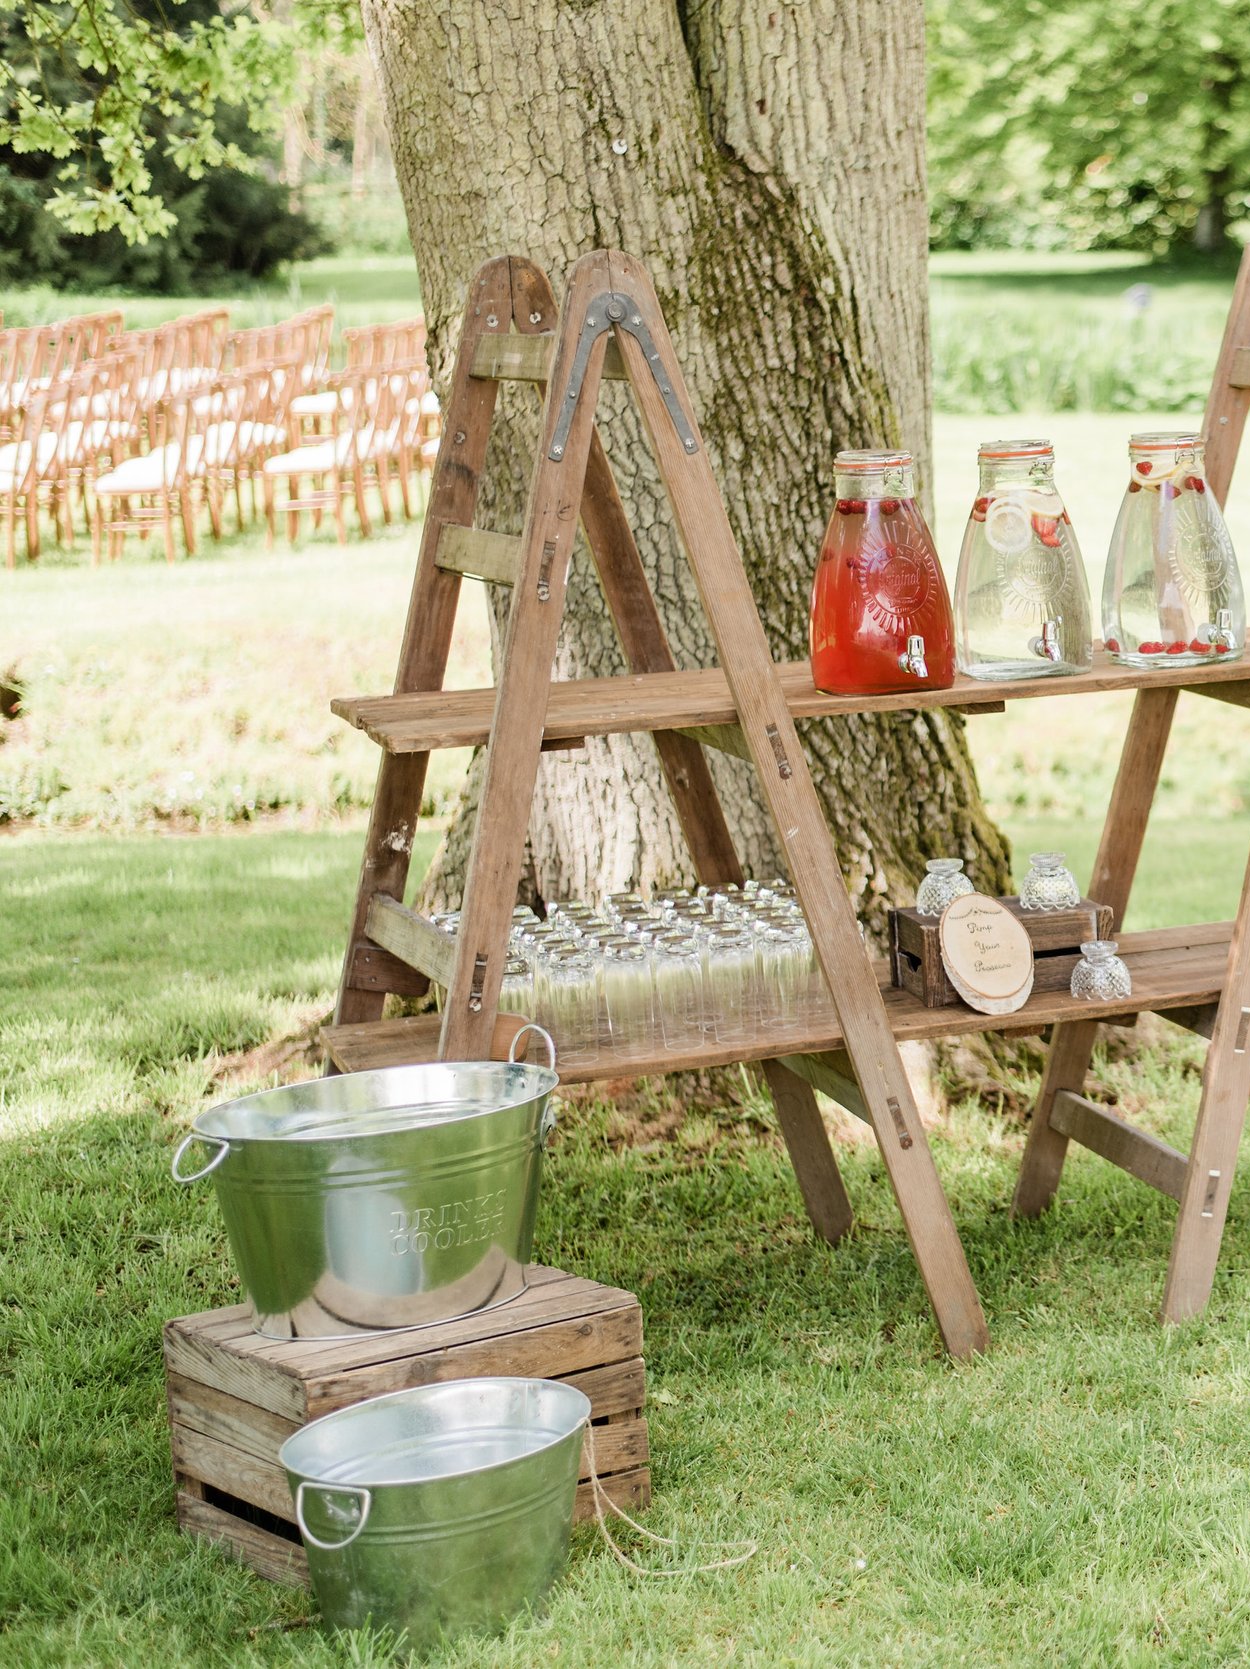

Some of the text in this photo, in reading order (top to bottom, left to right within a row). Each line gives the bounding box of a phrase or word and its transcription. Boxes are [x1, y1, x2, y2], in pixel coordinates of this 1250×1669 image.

[966, 922, 993, 934] Pimp
[974, 941, 1001, 955] Your
[390, 1189, 506, 1233] DRINKS
[390, 1213, 505, 1257] COOLER
